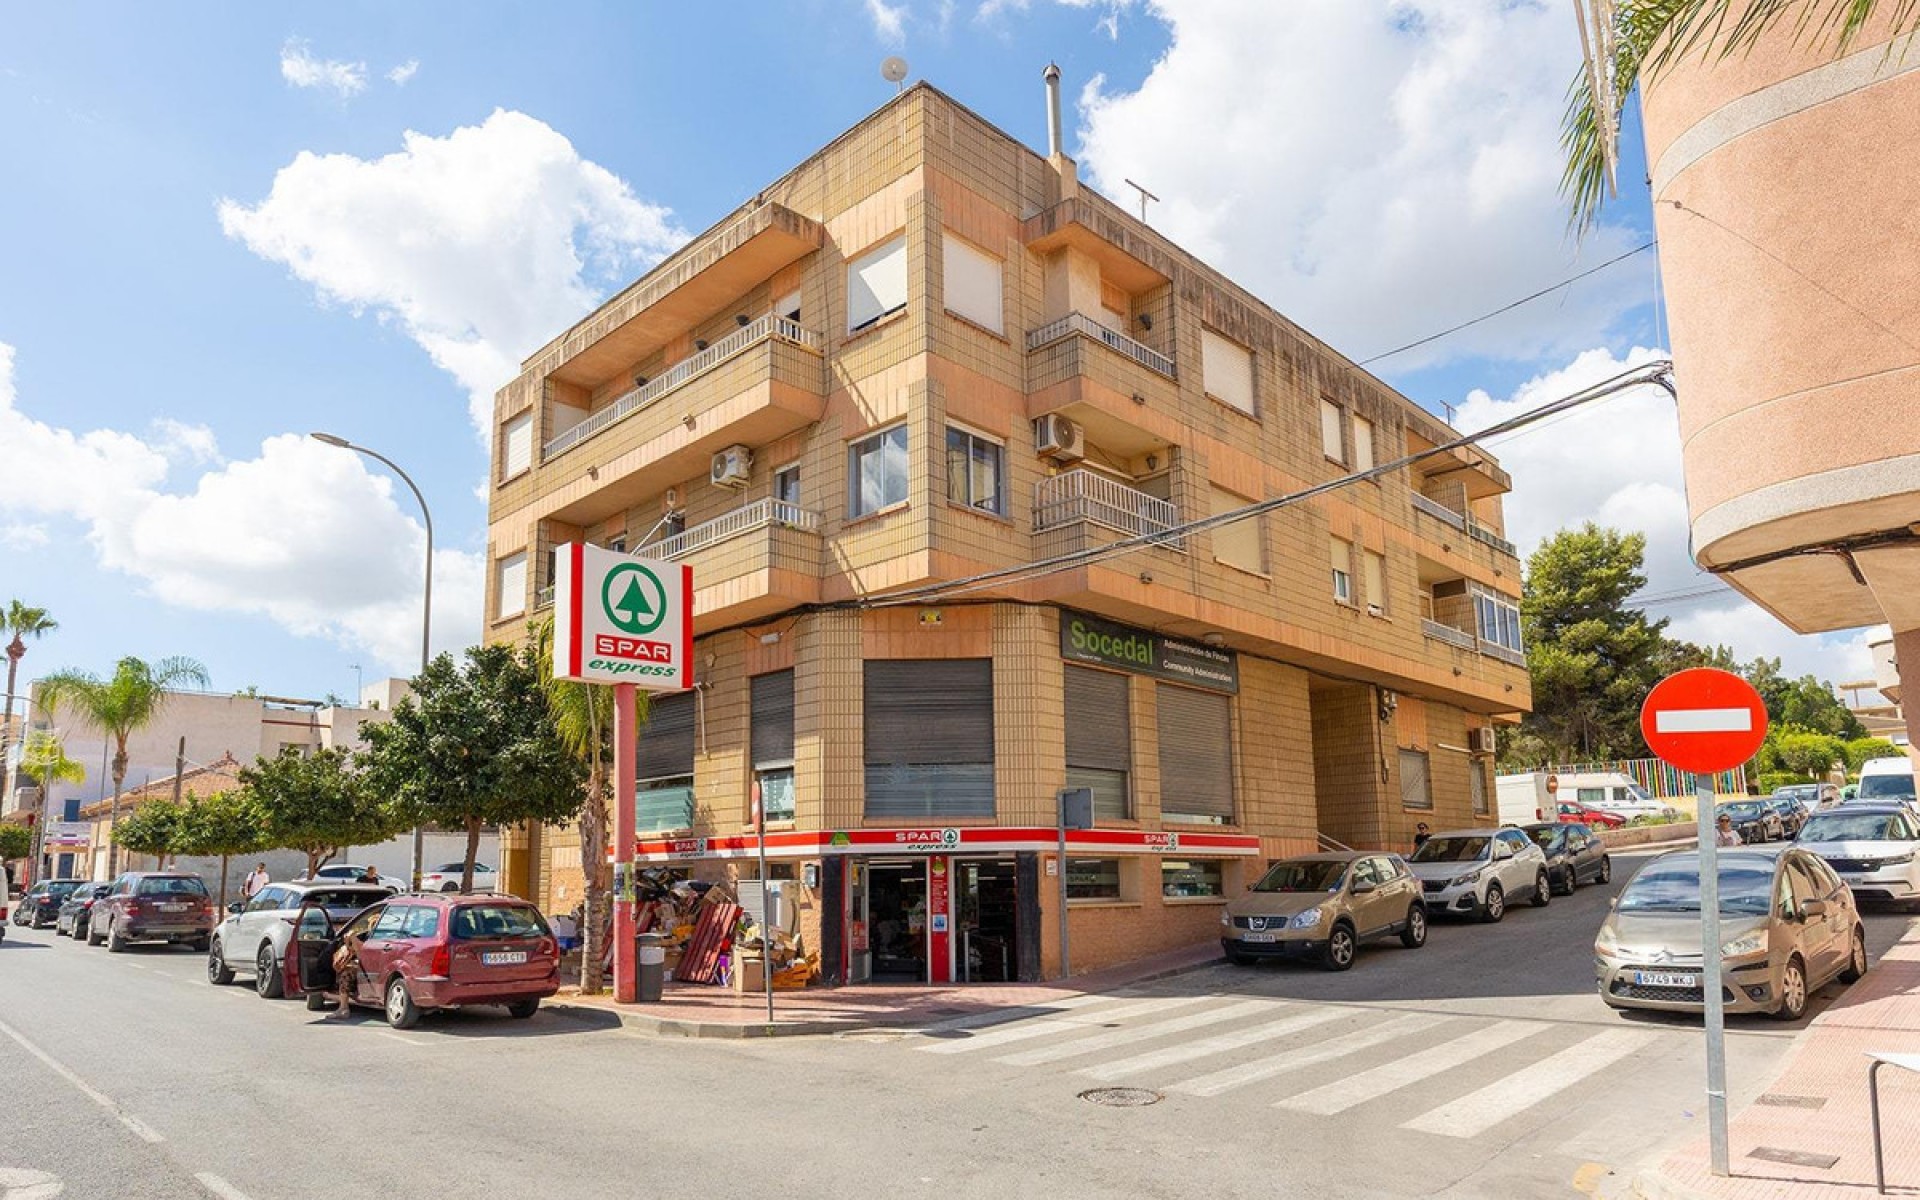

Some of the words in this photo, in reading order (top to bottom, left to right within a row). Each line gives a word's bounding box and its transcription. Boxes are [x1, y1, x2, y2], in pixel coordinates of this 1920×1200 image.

[598, 637, 669, 660] SPAR
[1071, 620, 1153, 665] Socedal
[588, 658, 677, 677] express
[1163, 659, 1195, 676] Community
[895, 831, 941, 842] SPAR
[1143, 834, 1169, 845] SPAR
[674, 840, 697, 852] SPAR
